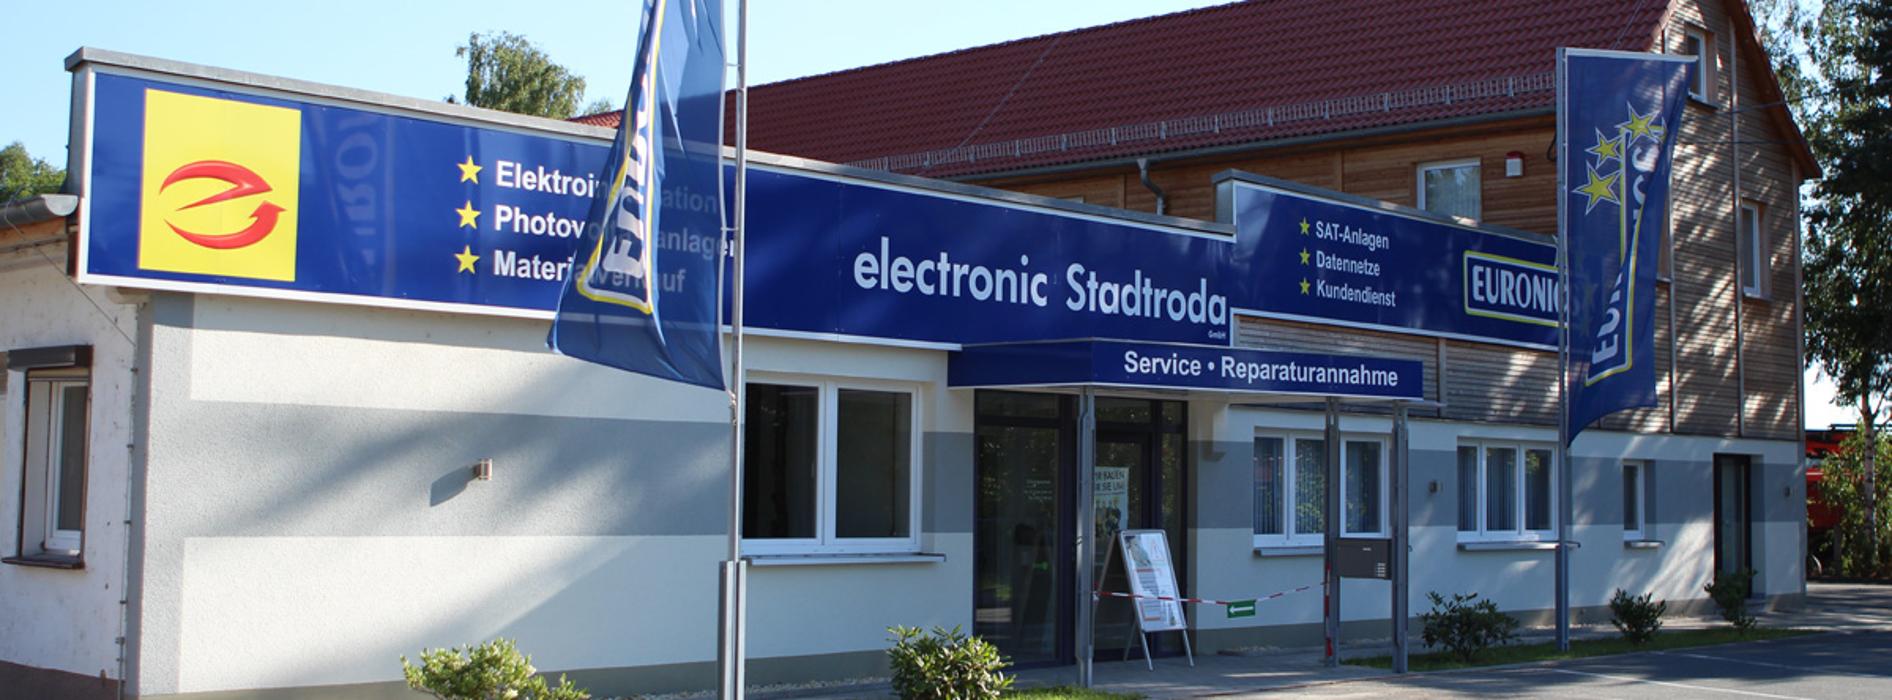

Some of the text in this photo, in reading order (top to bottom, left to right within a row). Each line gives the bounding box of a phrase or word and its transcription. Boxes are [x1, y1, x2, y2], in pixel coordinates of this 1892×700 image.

[496, 159, 717, 214] Elektroination
[1315, 220, 1390, 251] SAT-Anlagen
[1316, 250, 1381, 276] Datennetze
[854, 236, 1227, 325] electronic Stadtroda
[1316, 279, 1396, 307] Kundendienst
[1124, 350, 1399, 387] Service Reparaturannahme
